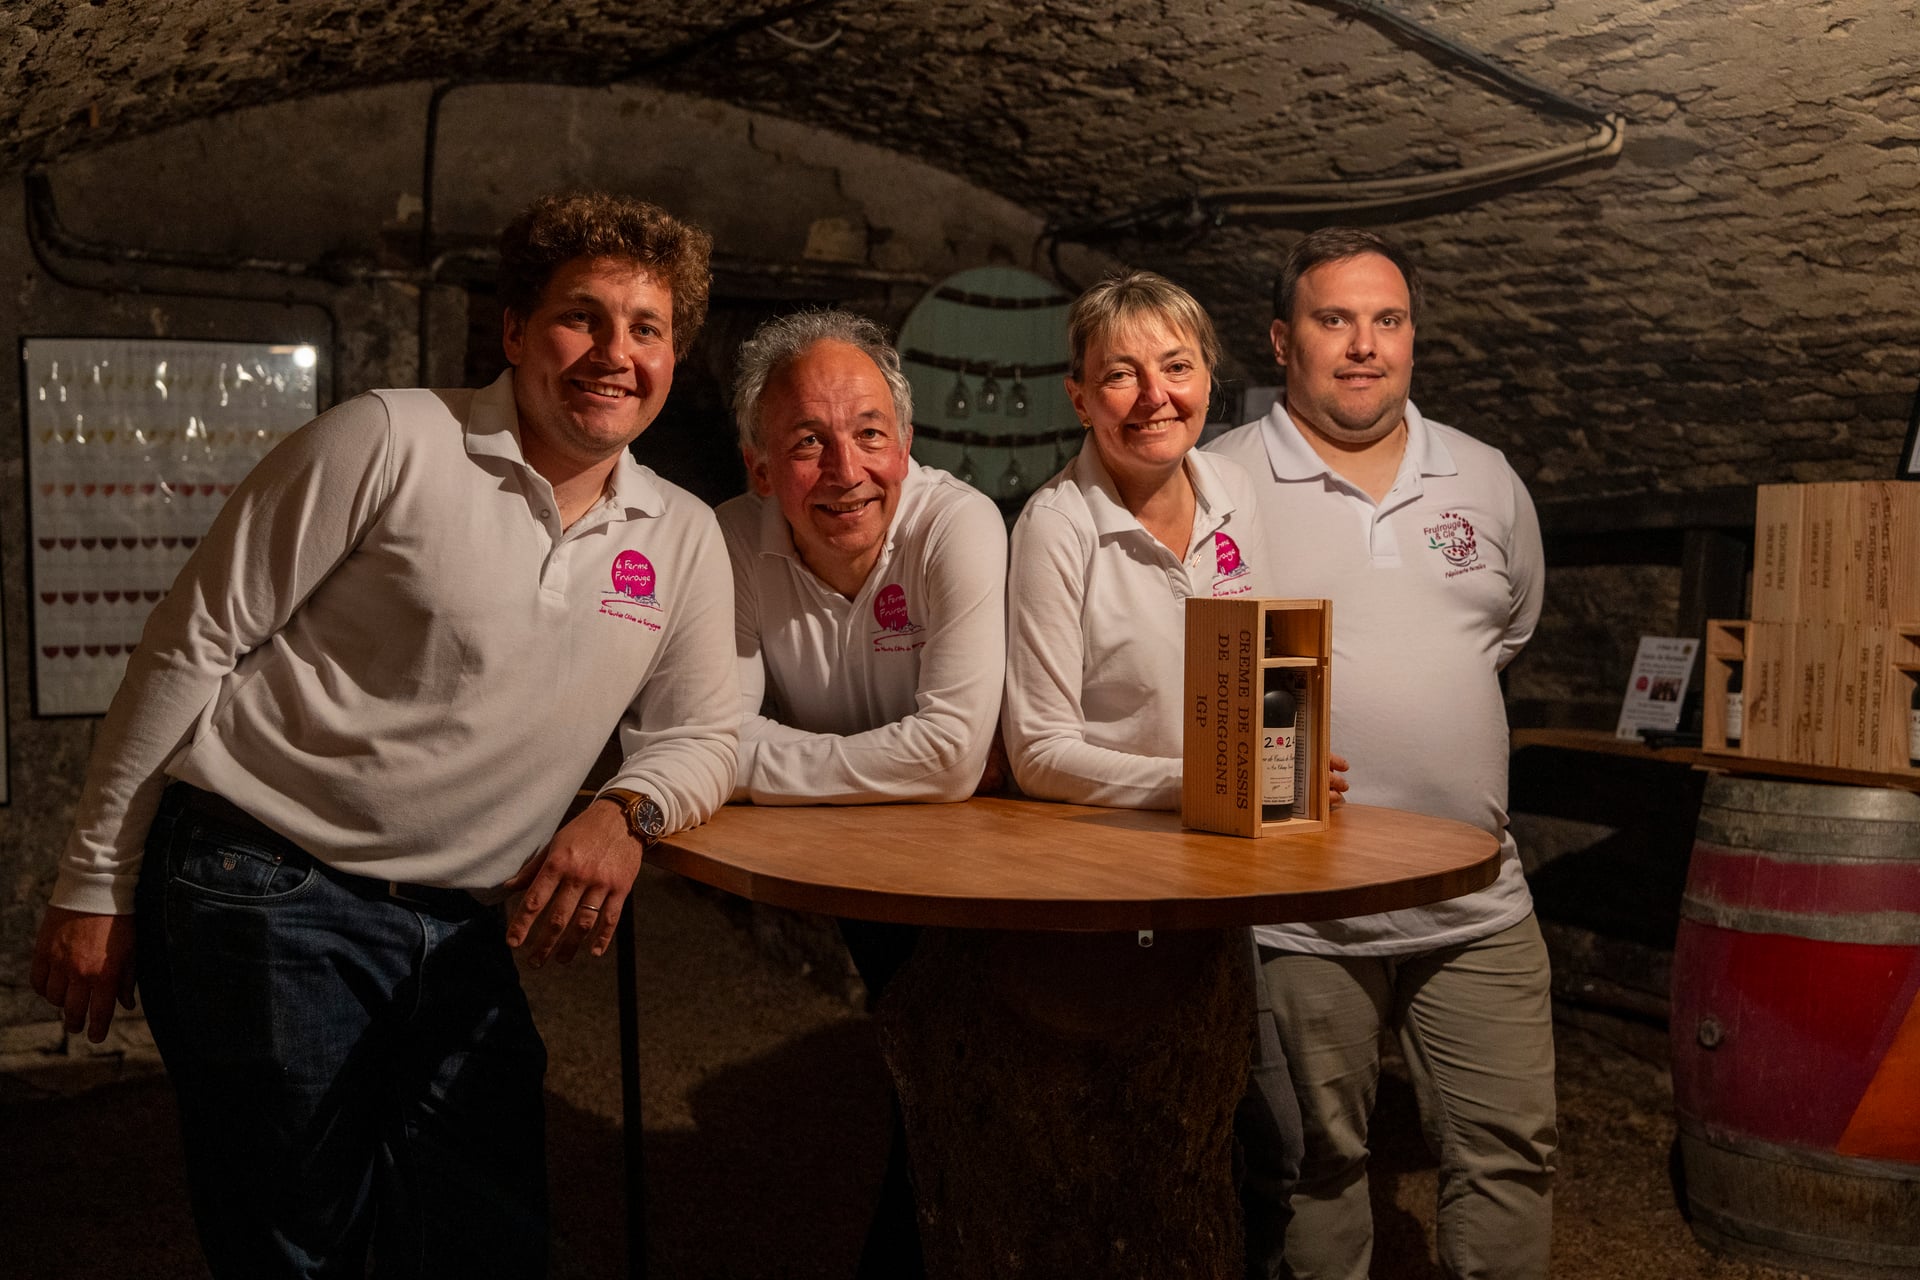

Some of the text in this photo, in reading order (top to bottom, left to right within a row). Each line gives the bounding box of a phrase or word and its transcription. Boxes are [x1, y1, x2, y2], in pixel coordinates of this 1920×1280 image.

[1216, 540, 1230, 550] erme
[625, 560, 648, 570] Ferme
[615, 571, 651, 586] Fruirouge
[1196, 695, 1208, 728] IGP
[1216, 633, 1230, 795] DE BOURGOGNE
[1236, 630, 1251, 810] CREME DE CASSIS
